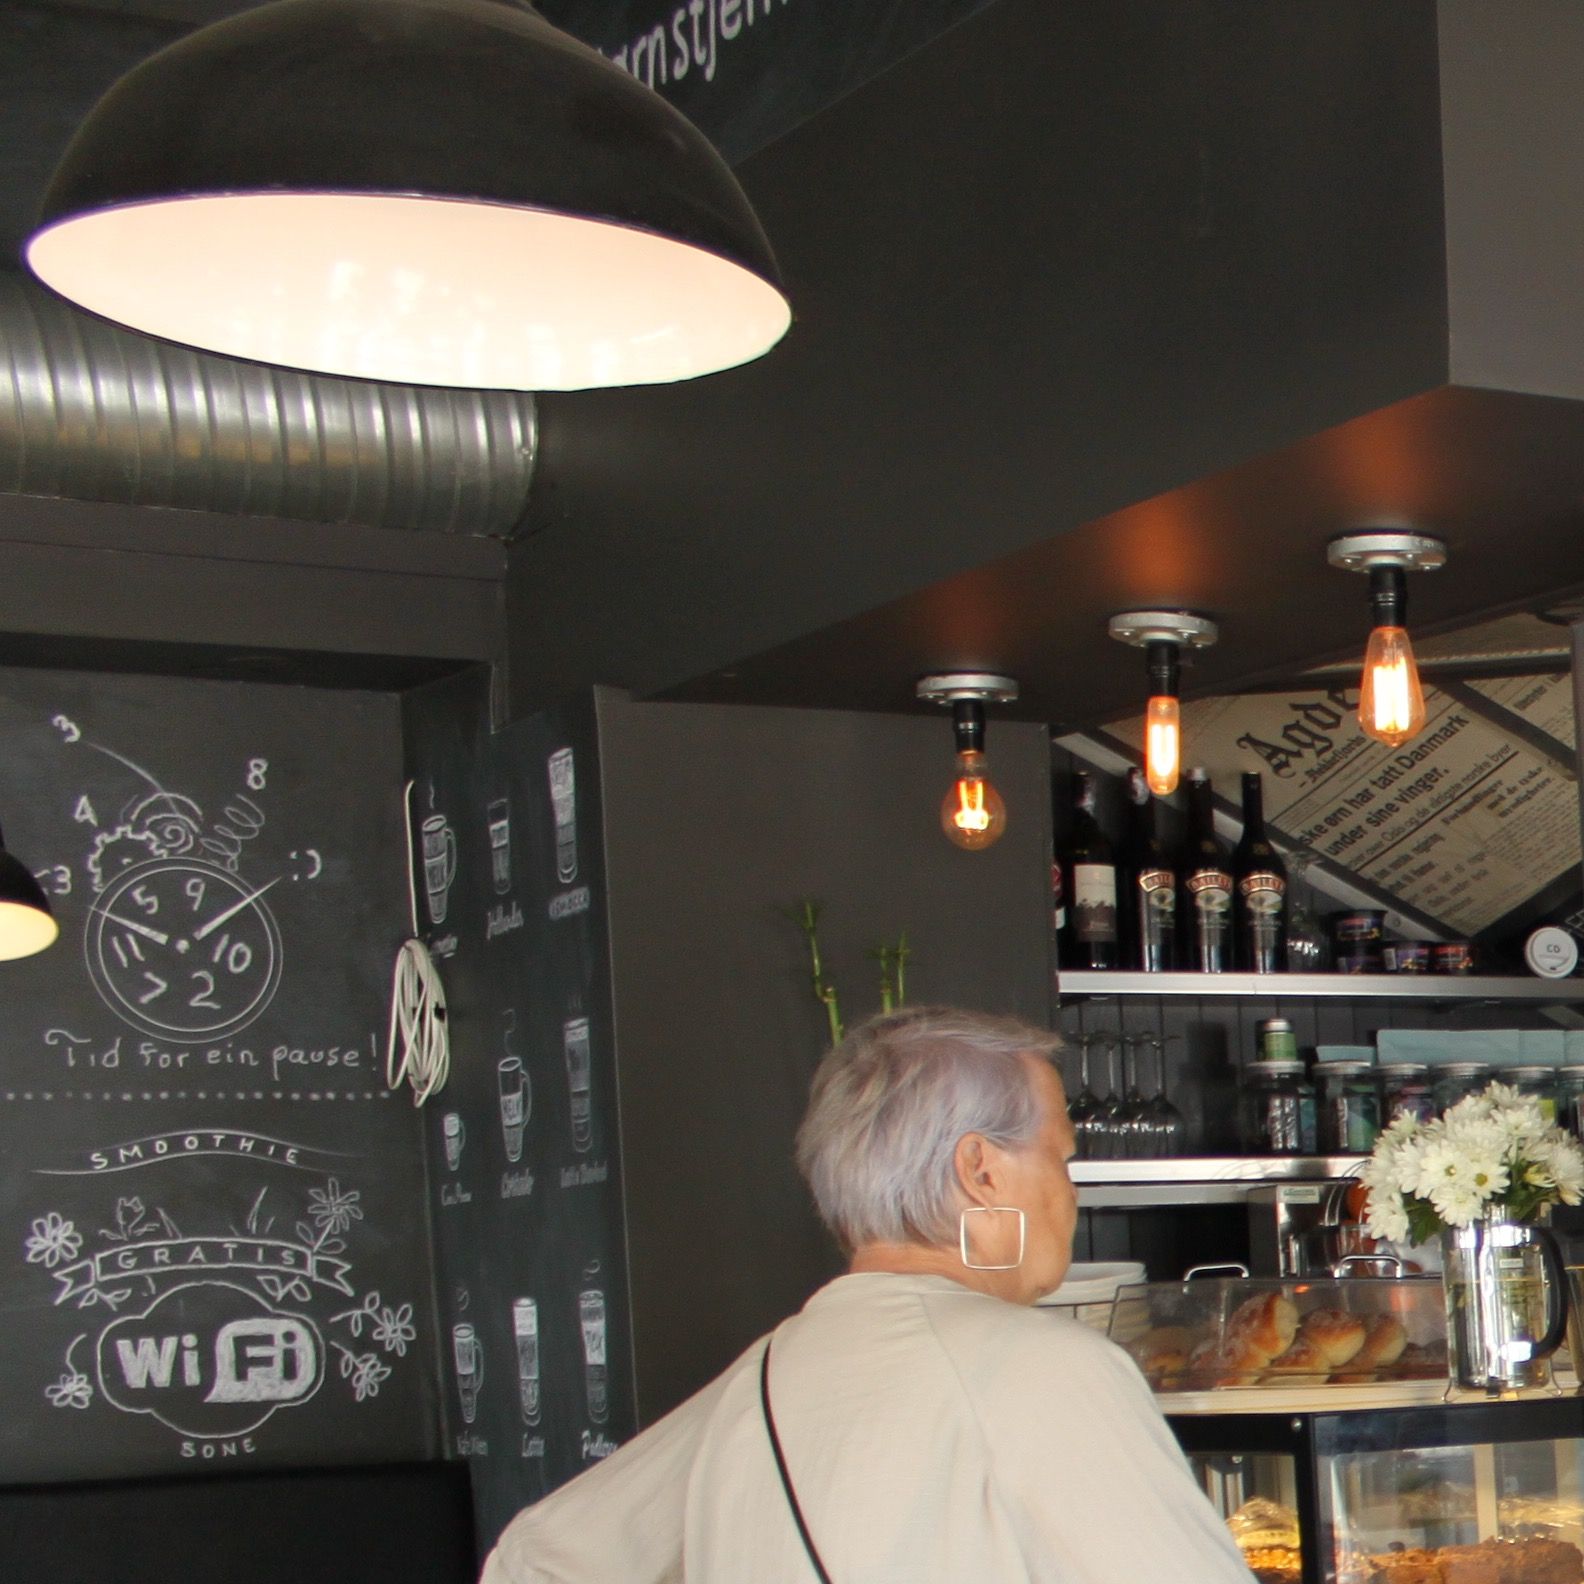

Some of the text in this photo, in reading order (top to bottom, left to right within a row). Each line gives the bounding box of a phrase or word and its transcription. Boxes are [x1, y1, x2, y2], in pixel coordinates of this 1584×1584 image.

[247, 758, 268, 790] 8
[1351, 780, 1375, 811] har
[1371, 764, 1403, 793] tatt
[1400, 713, 1469, 770] Danmark
[74, 794, 98, 827] 4
[1326, 767, 1450, 858] under sine vinger.
[132, 885, 158, 914] 5
[186, 878, 205, 911] 9
[213, 934, 252, 973] 10
[190, 970, 221, 1009] 2
[45, 1029, 122, 1067] Tid
[207, 1043, 258, 1066] ein
[118, 1243, 296, 1269] GRATIS
[180, 1438, 257, 1458] SONE
